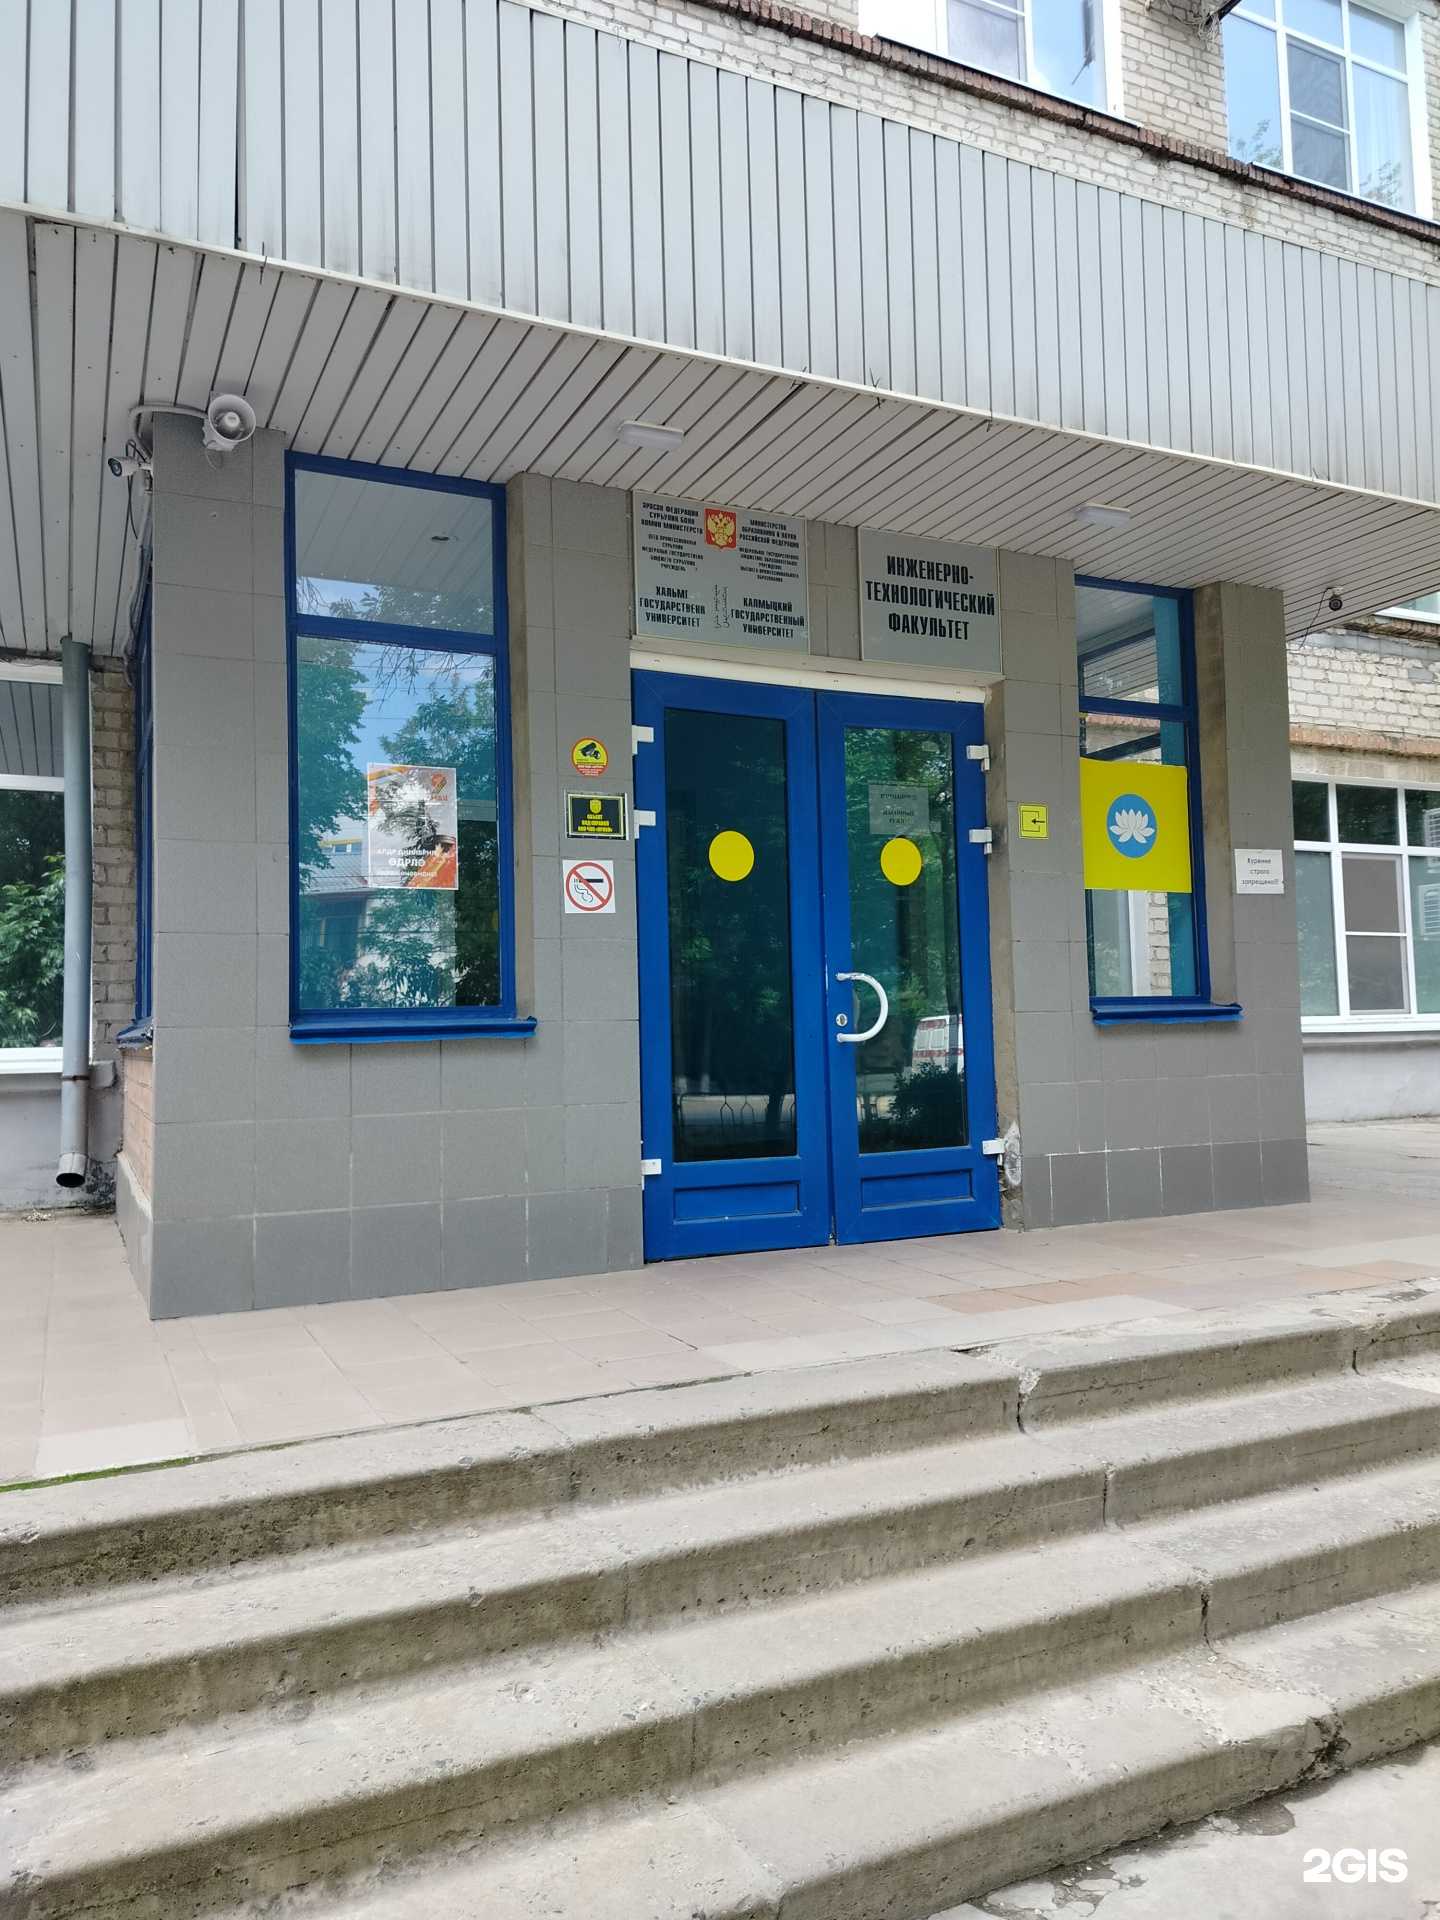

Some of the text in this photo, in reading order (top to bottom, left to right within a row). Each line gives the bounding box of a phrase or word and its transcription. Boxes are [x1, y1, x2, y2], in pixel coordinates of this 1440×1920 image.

[887, 555, 974, 585] ИНЖЕНЕРНО-
[639, 597, 706, 615] ГОСУДАРСТВЕНН
[743, 597, 793, 612] КАЛМЫЦКИЙ
[865, 580, 995, 616] ТЕХНОЛОГИЧЕСКИЙ
[645, 611, 700, 628] УНИВЕРСИТЕТ
[731, 609, 805, 627] ГОСУДАРСТВЕННЫЙ
[888, 612, 969, 640] ФАКУЛЬТЕТ
[742, 623, 794, 638] УНИВЕРСИТЕТ
